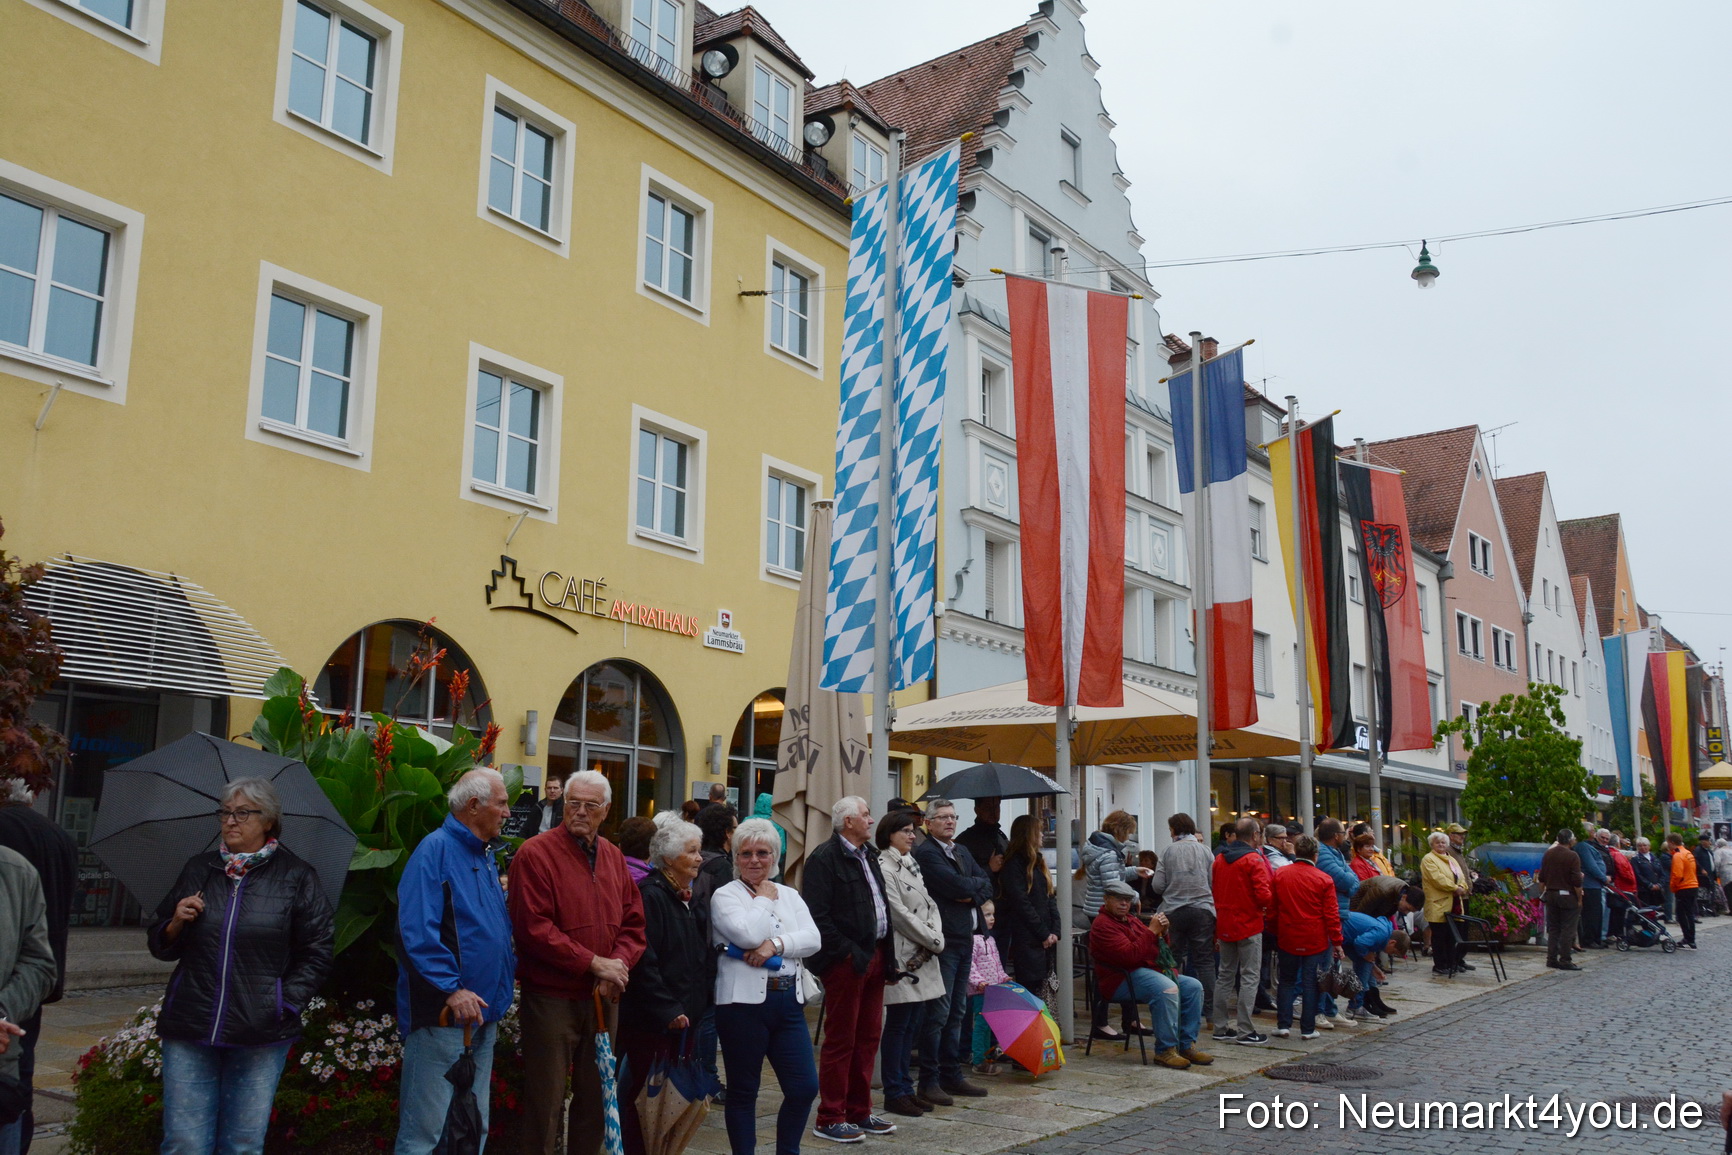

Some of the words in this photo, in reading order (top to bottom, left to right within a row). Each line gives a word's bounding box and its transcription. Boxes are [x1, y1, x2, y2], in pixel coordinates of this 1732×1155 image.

[539, 571, 607, 617] CAFÉ
[610, 599, 635, 621] AM
[638, 603, 699, 638] RATHAUS
[712, 628, 739, 640] Neumarkter
[707, 635, 743, 651] Lammsbräu
[915, 774, 925, 786] 24
